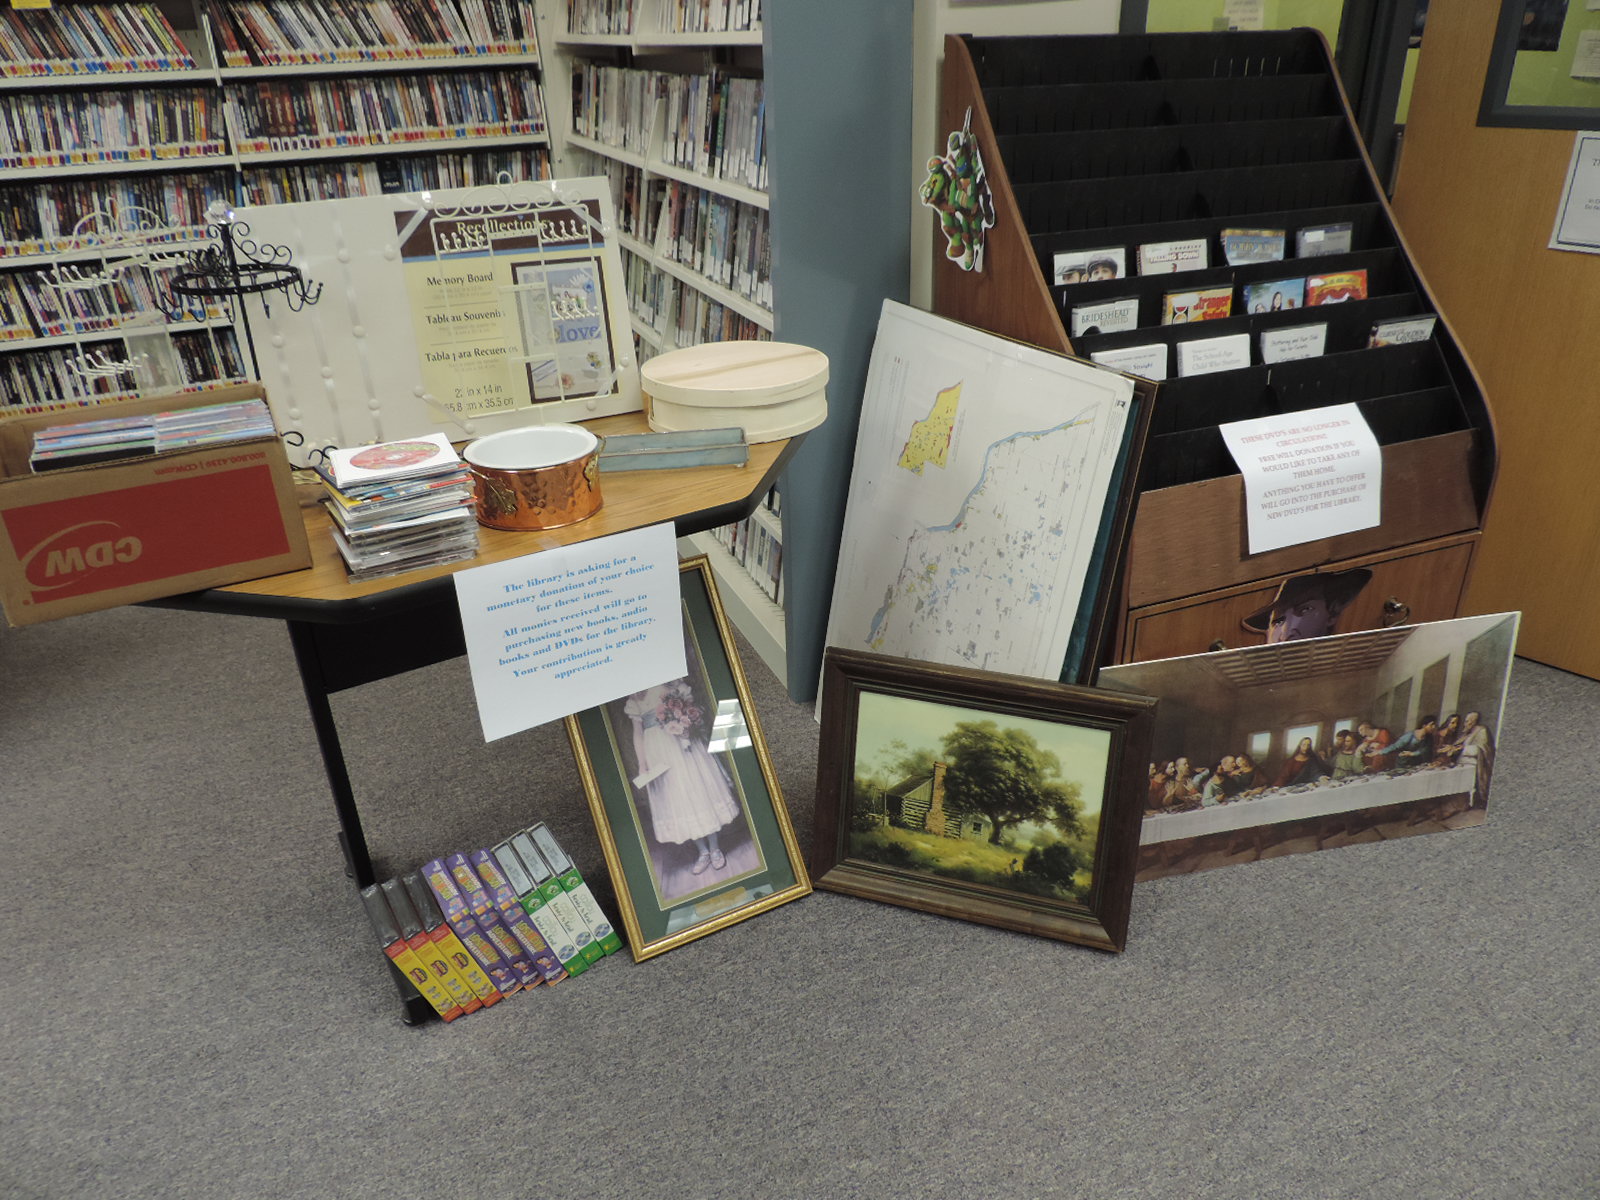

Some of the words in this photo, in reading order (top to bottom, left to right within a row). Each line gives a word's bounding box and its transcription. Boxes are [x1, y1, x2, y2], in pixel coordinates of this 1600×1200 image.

[467, 272, 494, 282] Board
[558, 323, 601, 343] love
[425, 351, 450, 362] Tabla
[455, 388, 463, 398] 2
[476, 388, 481, 396] x
[483, 384, 493, 395] 14
[484, 397, 502, 408] 35.5
[1241, 434, 1264, 444] THESE
[1313, 421, 1341, 431] LONGER
[1258, 454, 1276, 463] FREE
[1276, 450, 1295, 459] WILL
[1295, 443, 1333, 456] DONATION
[1333, 442, 1340, 450] IF
[1340, 440, 1356, 448] YOU
[1262, 463, 1289, 473] WOULD
[1289, 459, 1306, 468] LIKE
[1306, 456, 1317, 465] TO
[1317, 453, 1336, 463] TAKE
[1336, 451, 1351, 459] ANY
[1350, 449, 1360, 457] OF
[1263, 484, 1300, 499] ANYTHING
[1299, 482, 1315, 491] YOU
[1316, 478, 1335, 488] HAVE
[1335, 476, 1345, 484] TO
[1345, 472, 1366, 482] OFFER
[1292, 469, 1314, 480] THEM
[1261, 501, 1279, 510] WILL
[1279, 498, 1290, 507] GO
[1291, 495, 1309, 505] INTO
[1309, 491, 1323, 501] THE
[1322, 485, 1358, 498] PURCHASE
[1267, 509, 1284, 520] NEW
[1305, 504, 1319, 513] FOR
[1320, 501, 1333, 510] THE
[44, 536, 143, 578] CDW
[503, 584, 524, 593] The
[527, 574, 563, 587] library
[577, 563, 611, 575] asking
[613, 558, 628, 566] for
[487, 595, 536, 612] monetary
[540, 582, 585, 598] donation
[587, 576, 597, 585] of
[600, 572, 622, 585] your
[625, 564, 654, 576] choice
[536, 604, 552, 613] for
[554, 596, 580, 608] these
[583, 588, 613, 600] items.
[504, 627, 518, 637] All
[521, 618, 558, 633] monies
[560, 605, 600, 622] received
[603, 599, 621, 610] will
[623, 597, 635, 606] go
[505, 629, 562, 653] purchasing
[564, 624, 584, 634] new
[587, 615, 619, 628] books,
[621, 605, 648, 618] audio
[499, 653, 530, 666] books
[533, 644, 551, 656] and
[555, 637, 583, 650] DVDs
[586, 632, 601, 641] for
[603, 627, 618, 636] the
[621, 617, 656, 631] library.
[513, 666, 538, 677] Your
[541, 647, 602, 669] contribution
[615, 633, 647, 649] greatly
[554, 655, 613, 679] appreciated.
